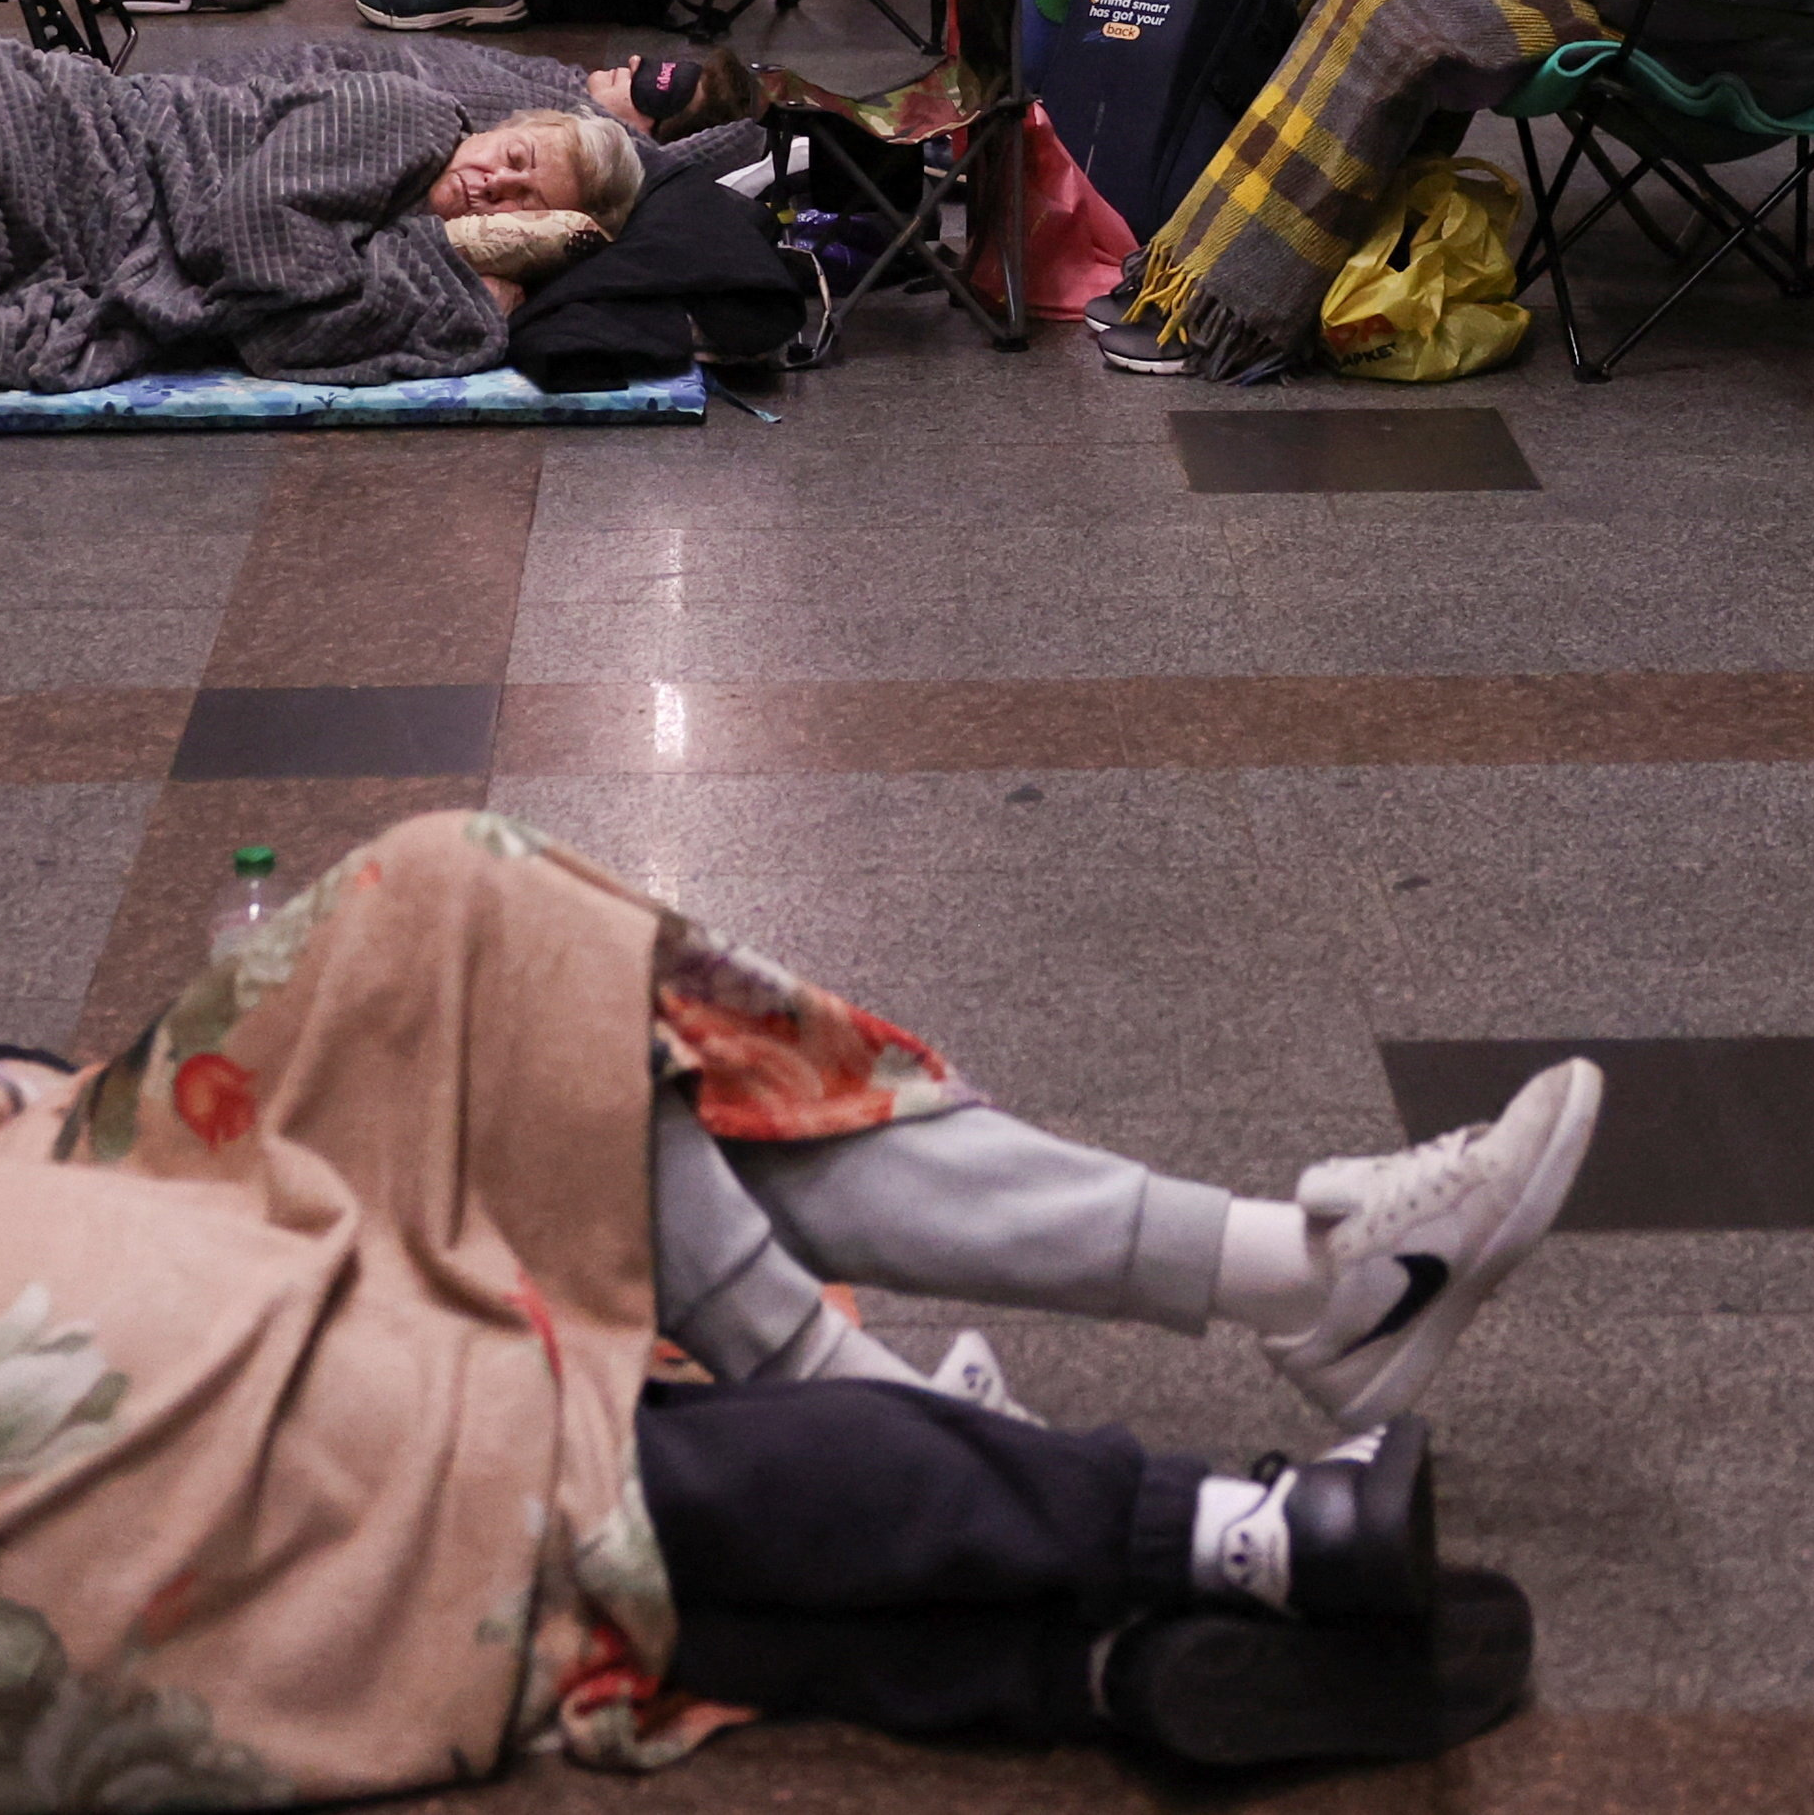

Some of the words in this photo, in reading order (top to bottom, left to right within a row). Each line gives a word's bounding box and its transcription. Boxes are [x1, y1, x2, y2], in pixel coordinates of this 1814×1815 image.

[1132, 1, 1170, 15] smart
[1089, 5, 1111, 19] has
[1112, 10, 1134, 23] got
[1136, 14, 1166, 27] your
[1106, 23, 1136, 38] back
